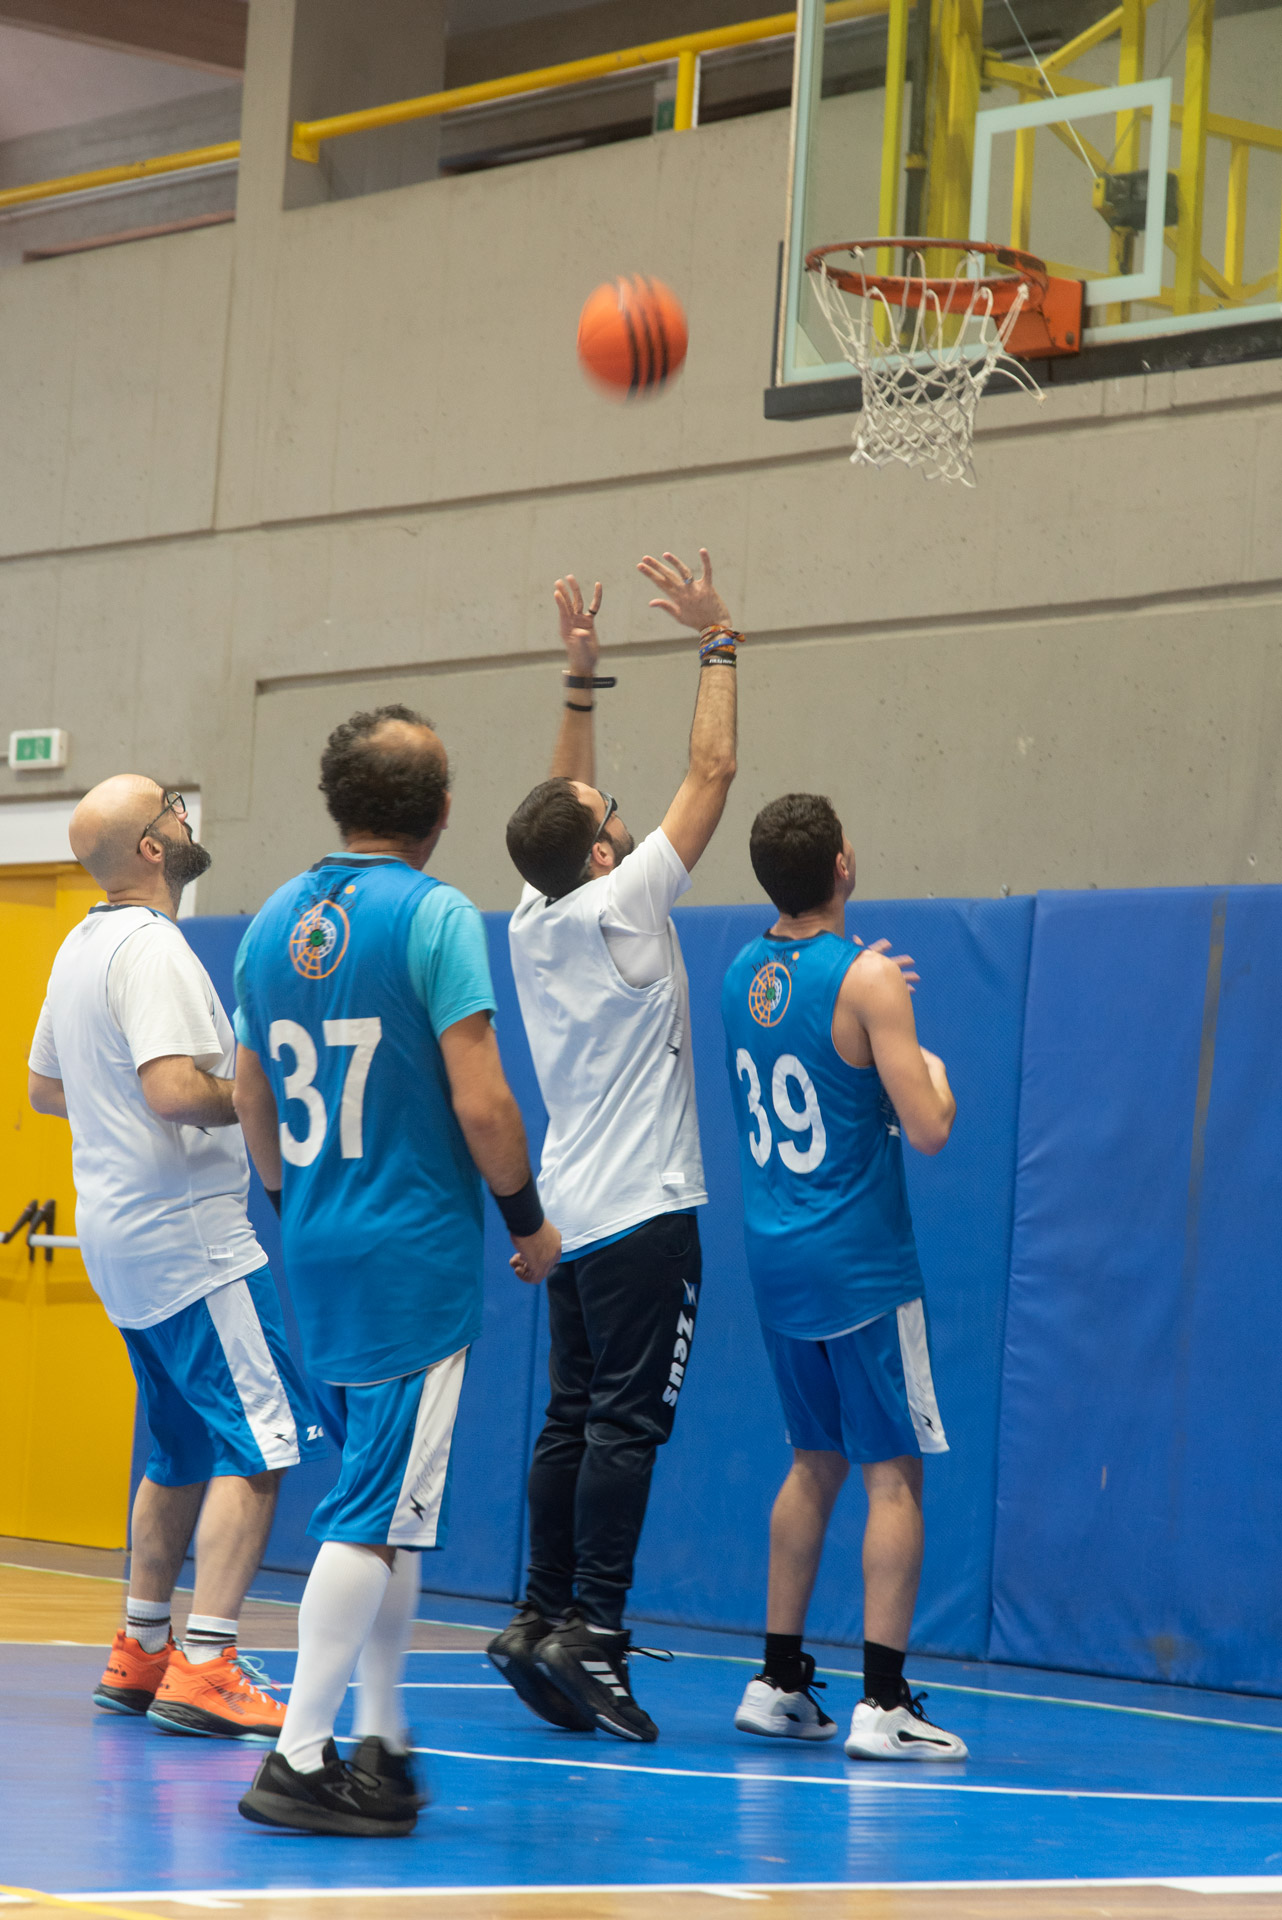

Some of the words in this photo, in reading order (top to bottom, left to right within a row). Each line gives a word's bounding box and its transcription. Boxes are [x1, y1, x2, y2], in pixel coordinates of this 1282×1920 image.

[269, 1017, 383, 1167] 37
[736, 1047, 827, 1175] 39
[662, 1310, 694, 1407] Zeus
